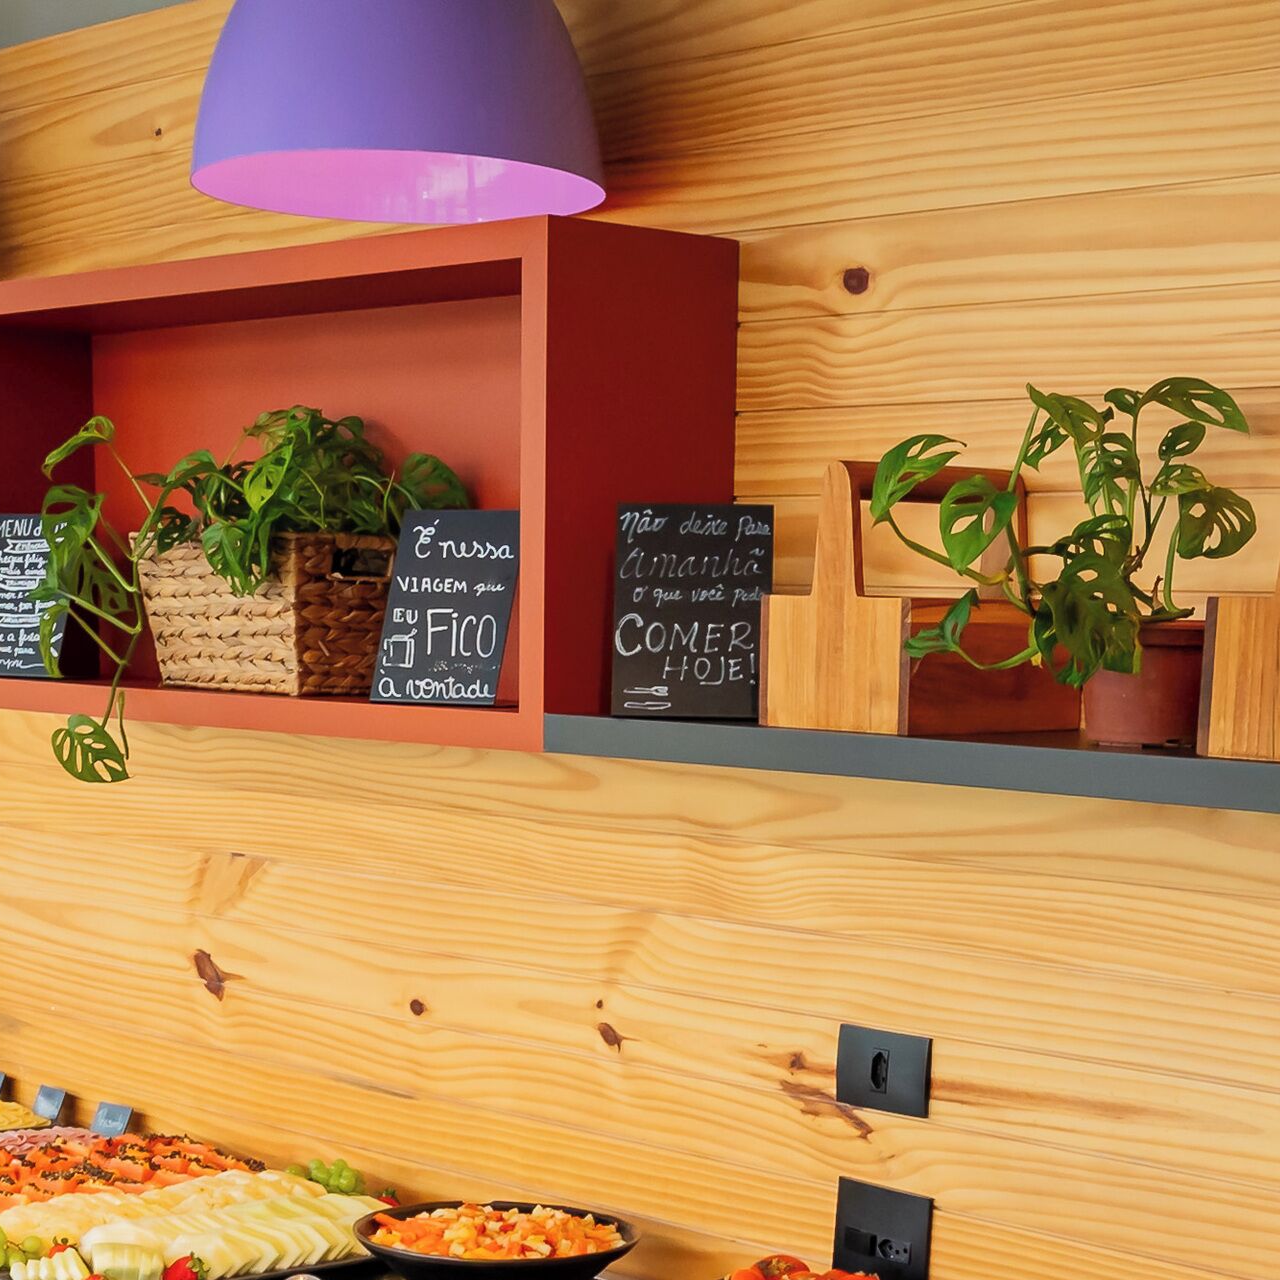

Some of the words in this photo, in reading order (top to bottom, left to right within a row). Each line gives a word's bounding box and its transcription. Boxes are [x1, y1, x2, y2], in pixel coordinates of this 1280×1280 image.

[680, 511, 727, 536] deixe
[438, 540, 514, 560] nessa
[396, 575, 468, 594] VIAGEM
[473, 581, 506, 597] que
[653, 588, 682, 608] que
[692, 583, 725, 603] você
[393, 607, 418, 624] EU
[615, 612, 754, 657] COMER
[662, 652, 756, 686] HOJE!
[406, 676, 496, 699] vontade
